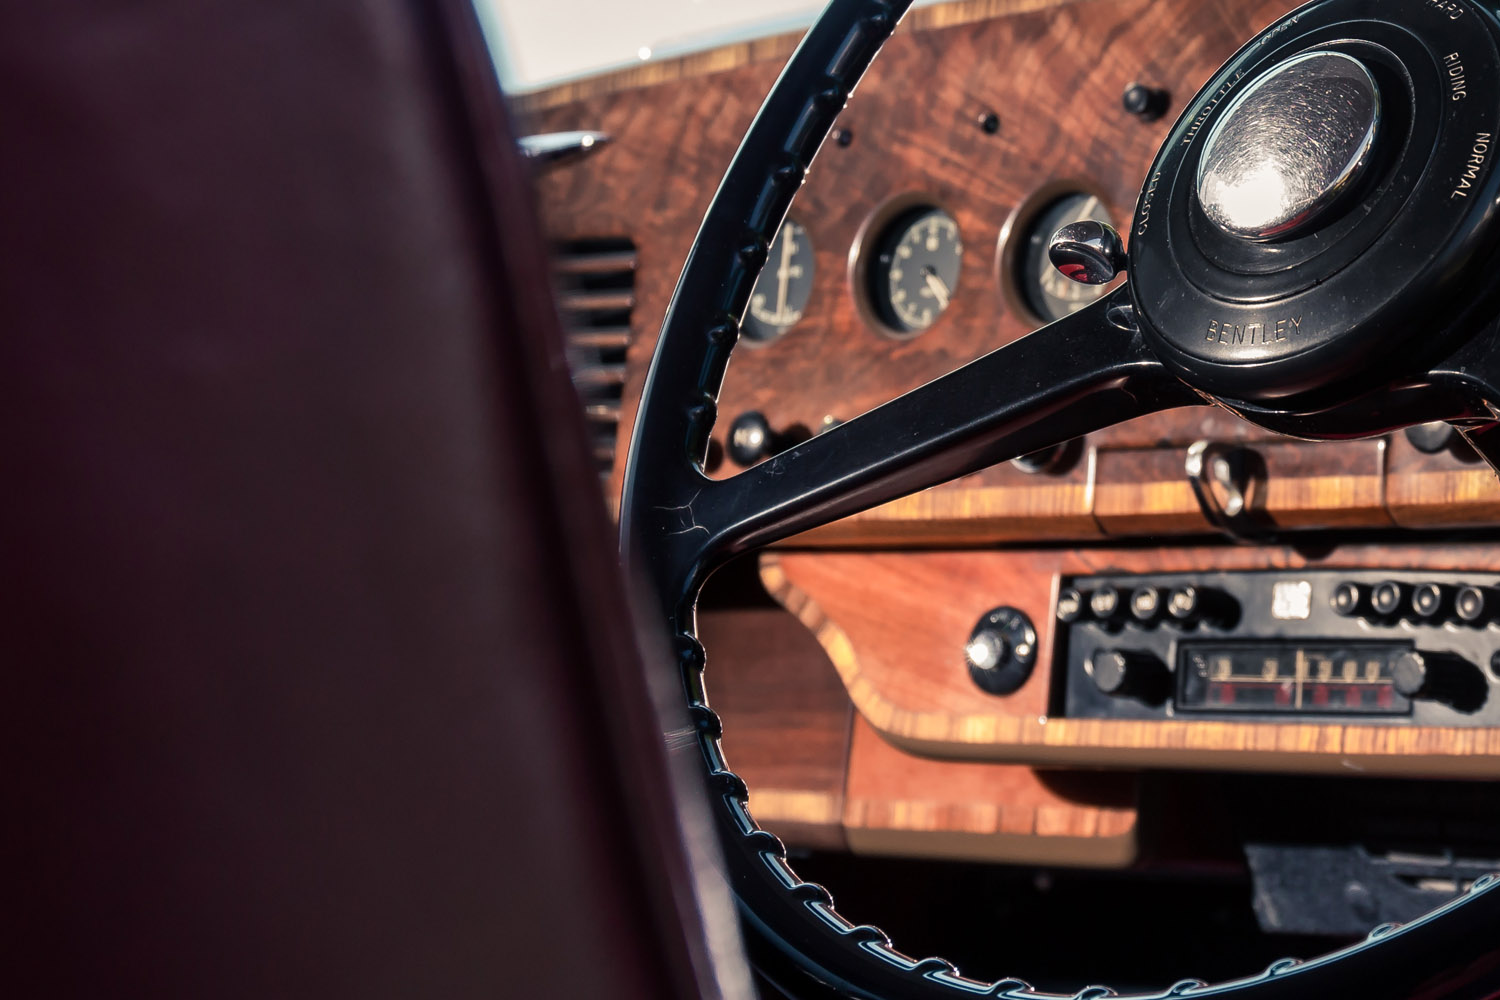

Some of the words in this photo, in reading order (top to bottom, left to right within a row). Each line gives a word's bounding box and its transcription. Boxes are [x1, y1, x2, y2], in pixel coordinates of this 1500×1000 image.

[1443, 52, 1468, 101] RIDING
[1450, 132, 1492, 199] NORMAL
[1205, 315, 1302, 346] BENTLEY
